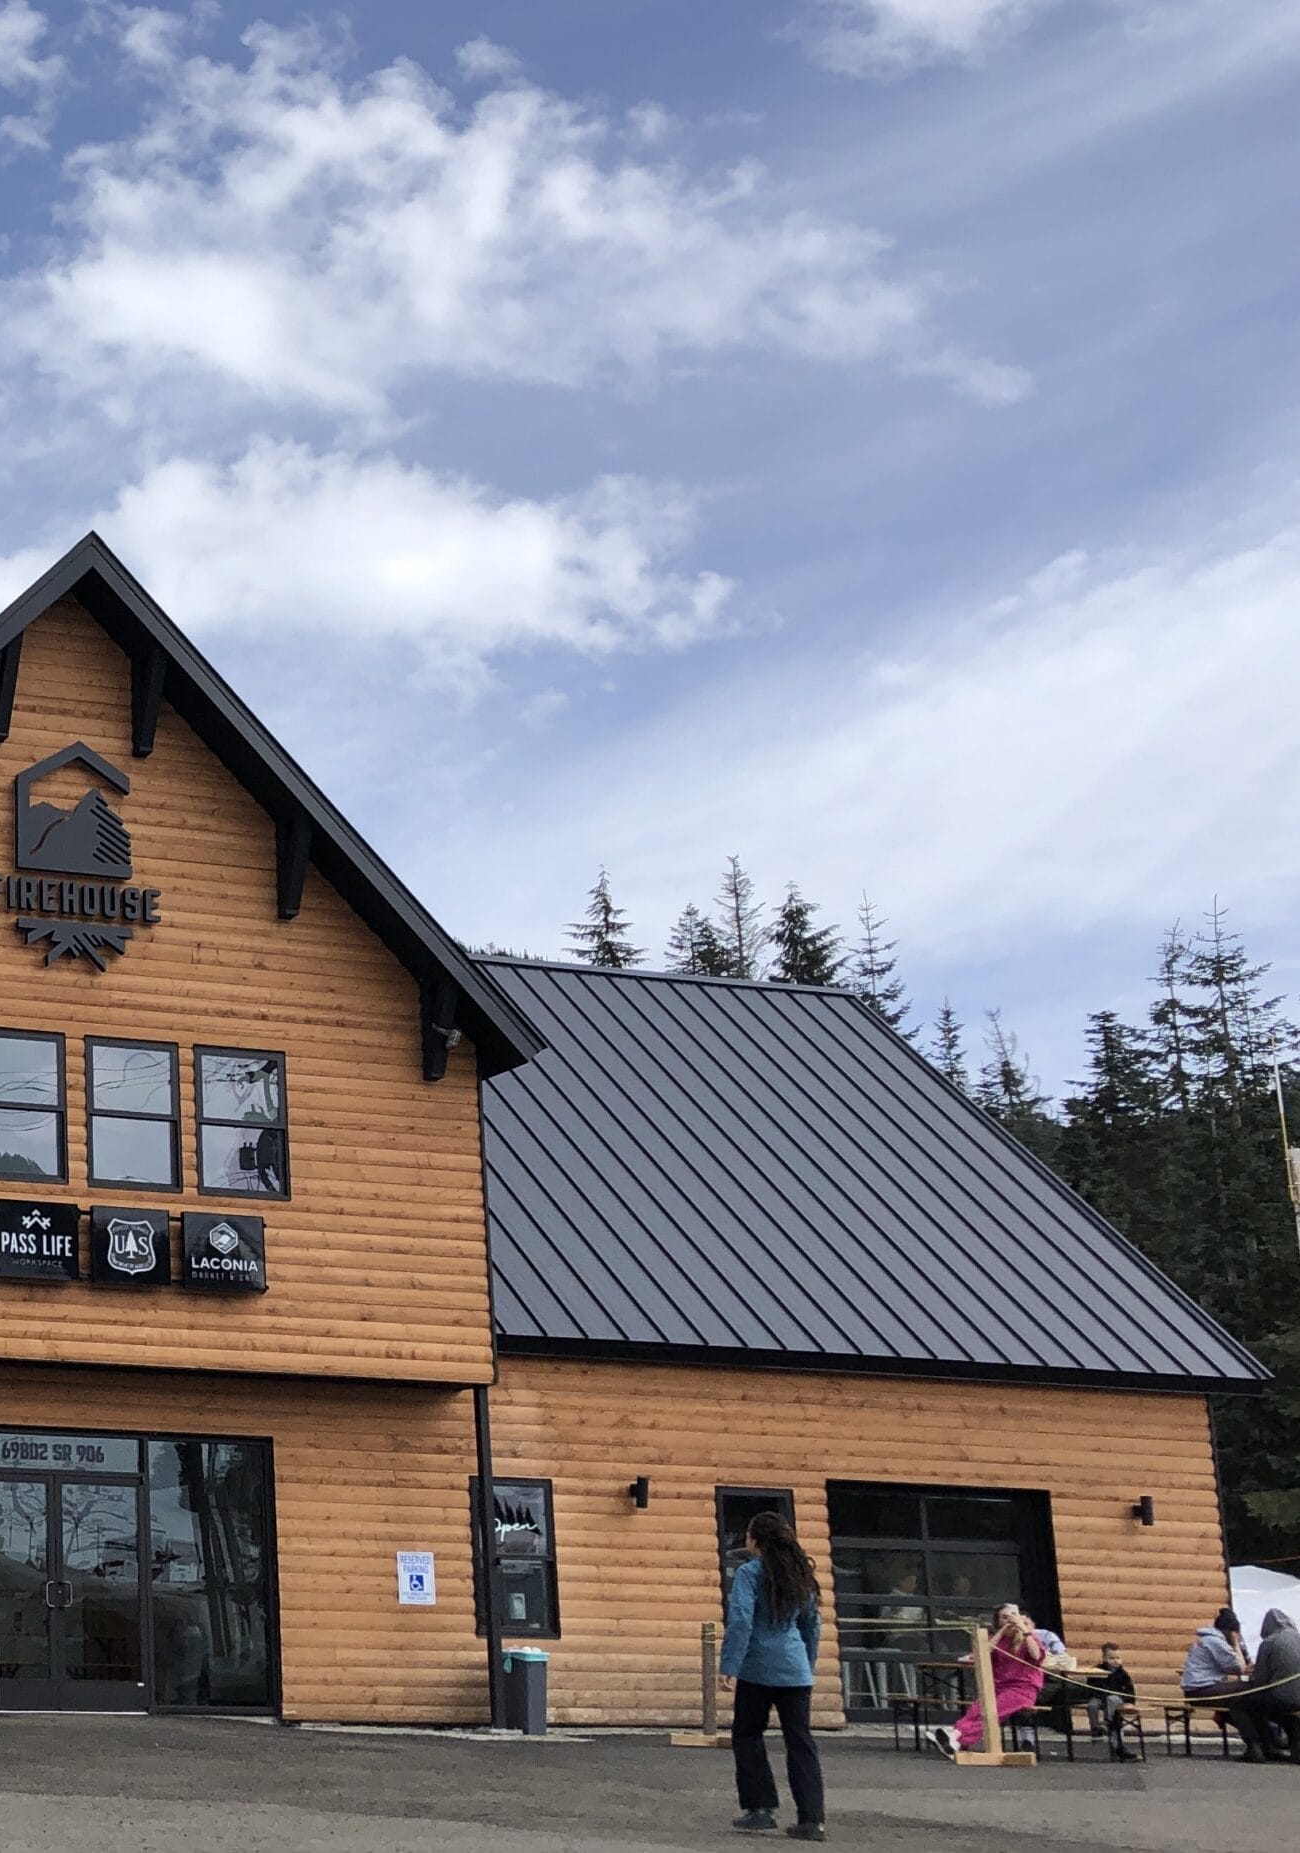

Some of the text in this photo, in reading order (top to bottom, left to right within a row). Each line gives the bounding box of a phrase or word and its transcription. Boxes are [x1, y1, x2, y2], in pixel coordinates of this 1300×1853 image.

[1, 1231, 73, 1257] PASS LIFE
[12, 1258, 63, 1268] WORKSPACE
[191, 1256, 259, 1272] LACONIA
[1, 1441, 105, 1463] 69802 SR 906
[400, 1555, 430, 1565] RESERVED
[403, 1564, 429, 1574] PARKING
